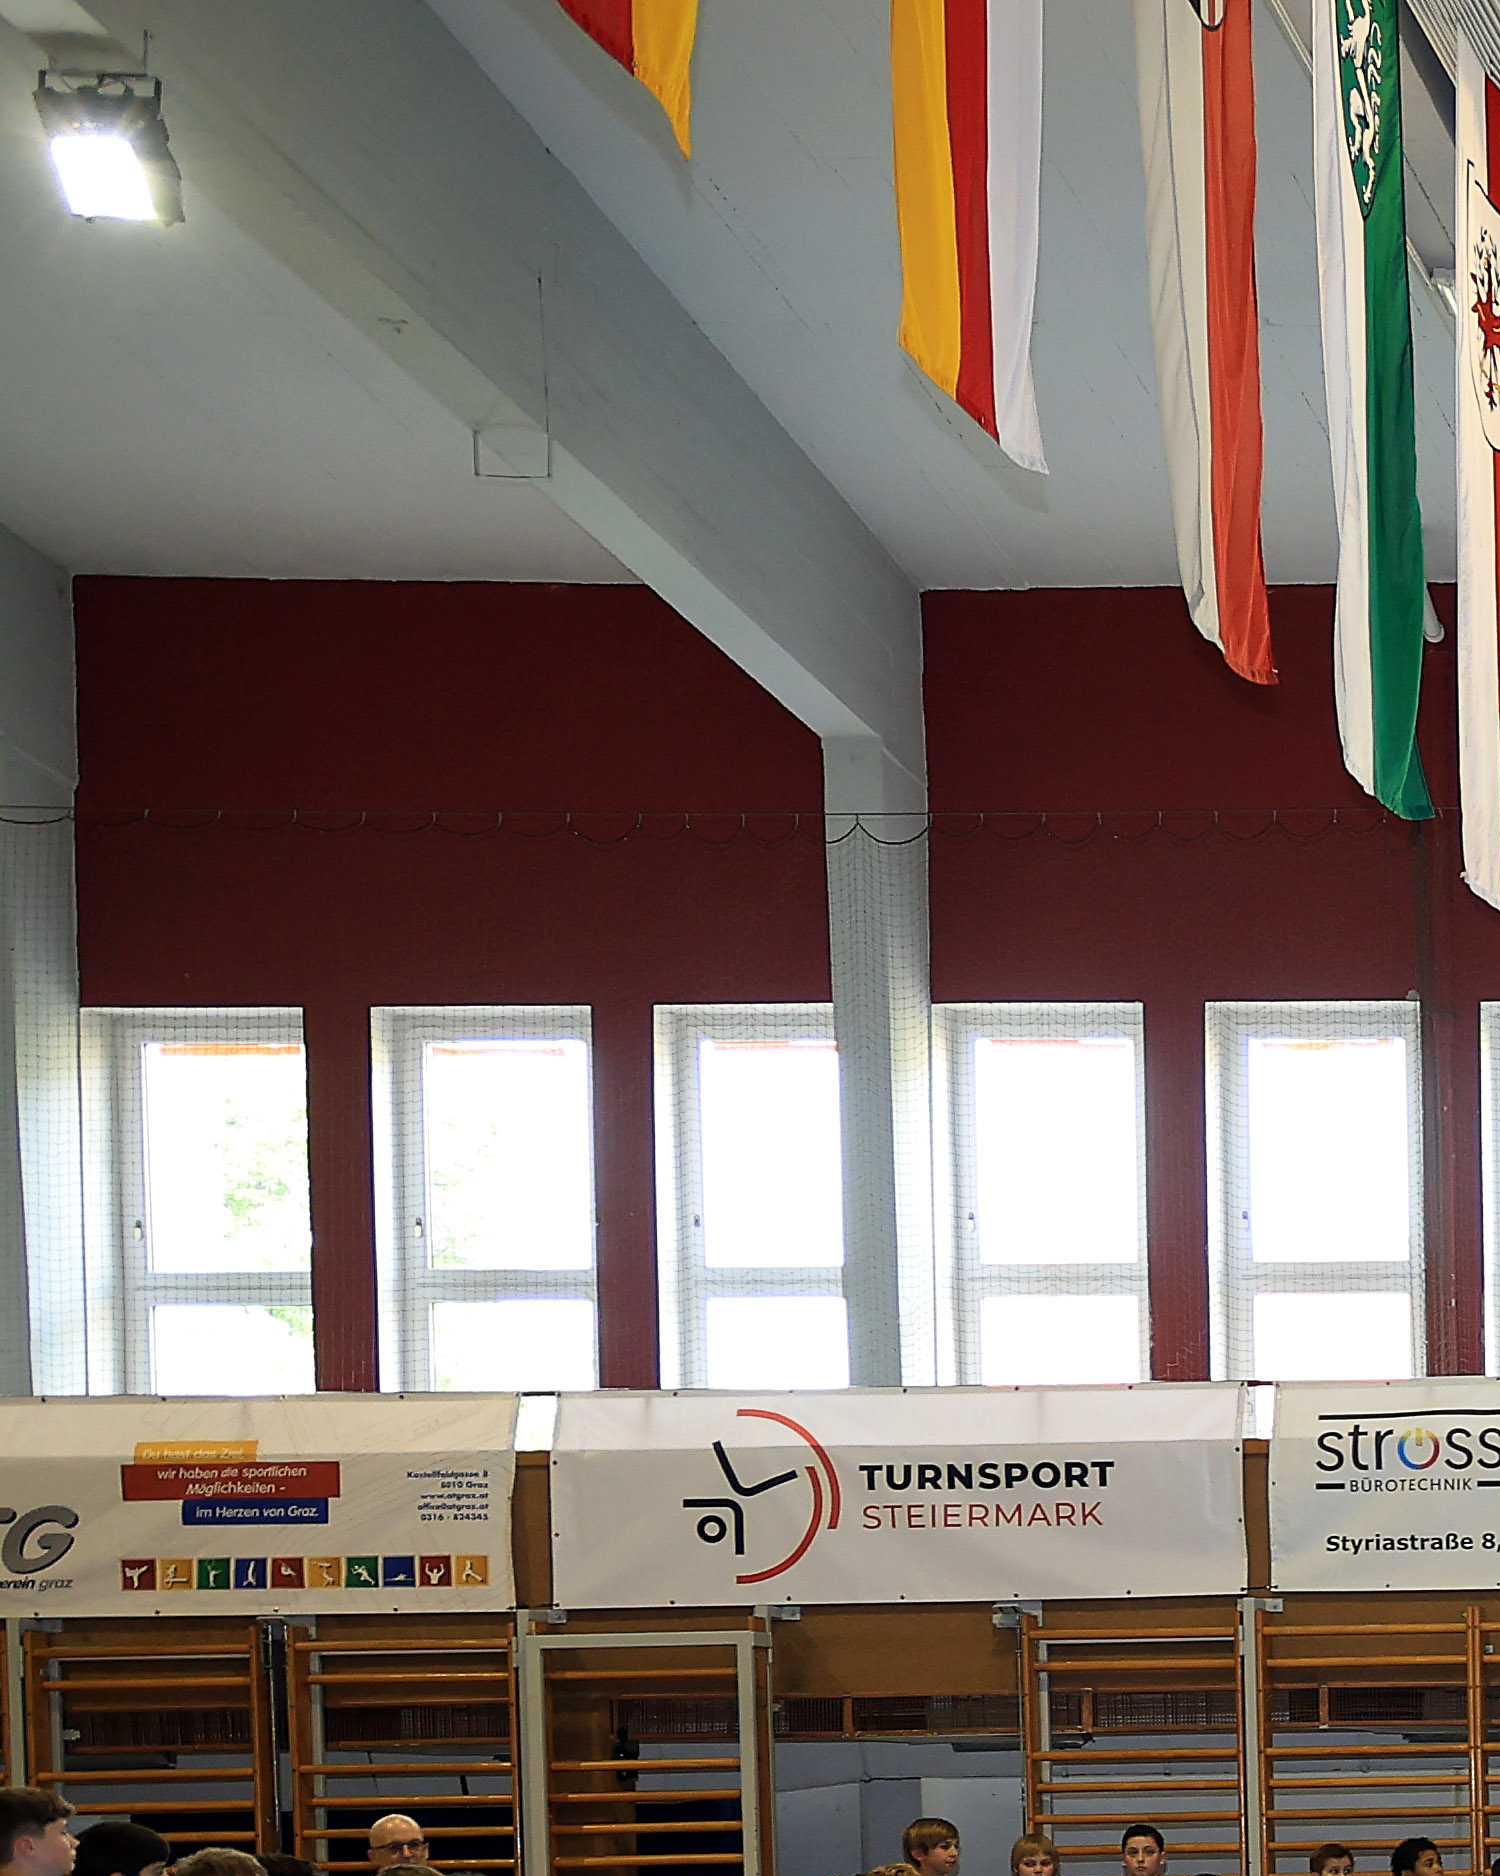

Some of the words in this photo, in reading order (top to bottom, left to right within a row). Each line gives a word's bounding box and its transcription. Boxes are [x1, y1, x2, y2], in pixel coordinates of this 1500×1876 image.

[157, 1468, 175, 1479] wir
[179, 1467, 218, 1478] haben
[221, 1466, 239, 1477] die
[242, 1465, 307, 1480] sportlichen
[859, 1461, 1115, 1490] TURNSPORT
[185, 1482, 276, 1498] Möglichkeiten
[466, 1481, 488, 1489] Graz
[1350, 1477, 1472, 1492] BÜROTECHNIK
[196, 1506, 212, 1518] im
[216, 1505, 260, 1518] Herzen
[263, 1507, 285, 1517] von
[420, 1513, 444, 1521] 0316
[863, 1501, 1103, 1529] STEIERMARK
[1326, 1533, 1474, 1555] Styriastraße
[39, 1579, 73, 1591] graz
